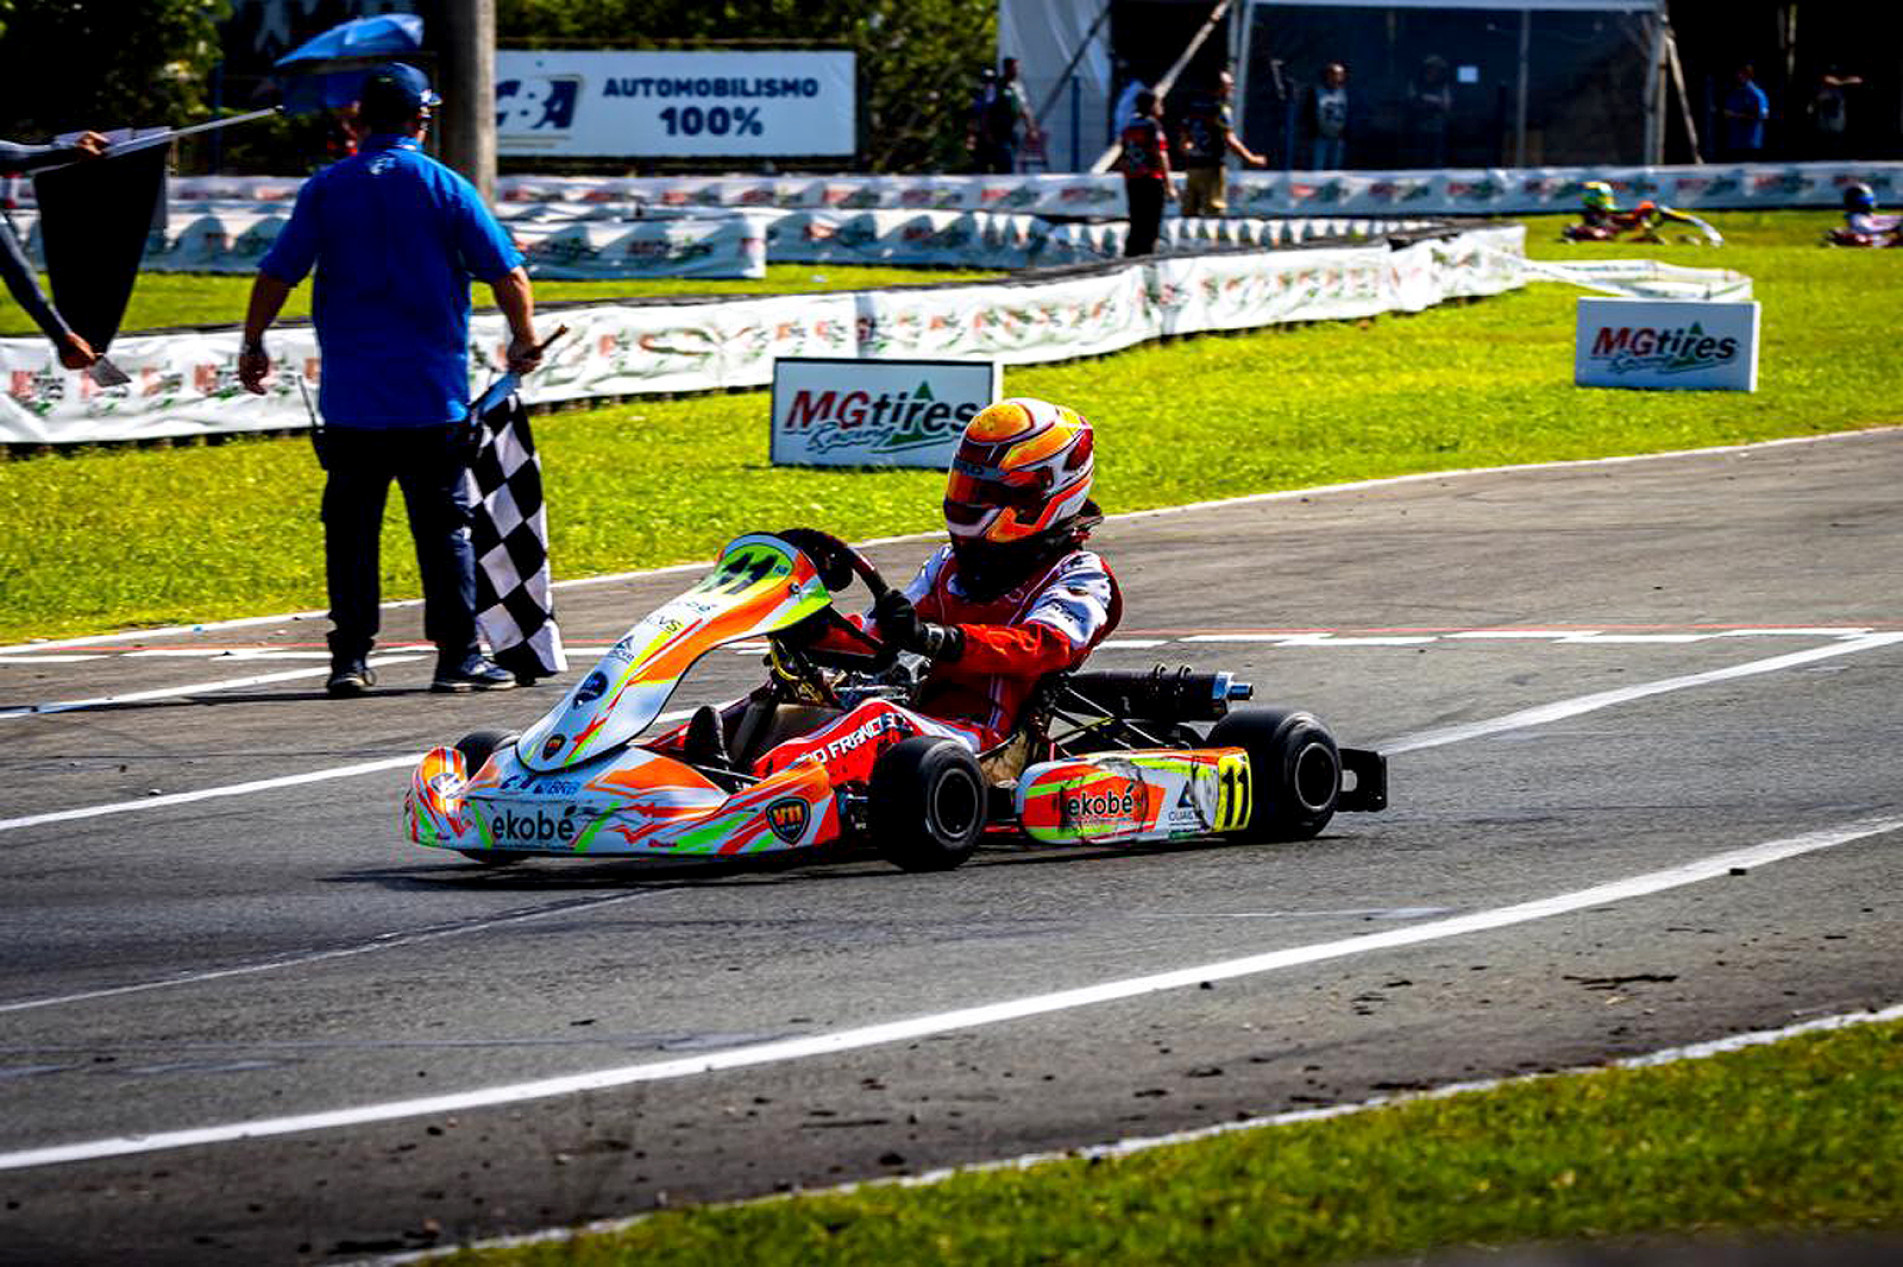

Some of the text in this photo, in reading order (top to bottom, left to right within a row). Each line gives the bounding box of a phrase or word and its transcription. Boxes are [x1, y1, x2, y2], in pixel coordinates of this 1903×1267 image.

[603, 77, 818, 98] AUTOMOBILISMO
[659, 106, 763, 136] 100%
[1590, 327, 1738, 359] MGtires
[784, 389, 980, 432] MGtires
[1067, 783, 1134, 816] ekobé
[1221, 765, 1249, 829] 11
[492, 805, 576, 840] ekobé
